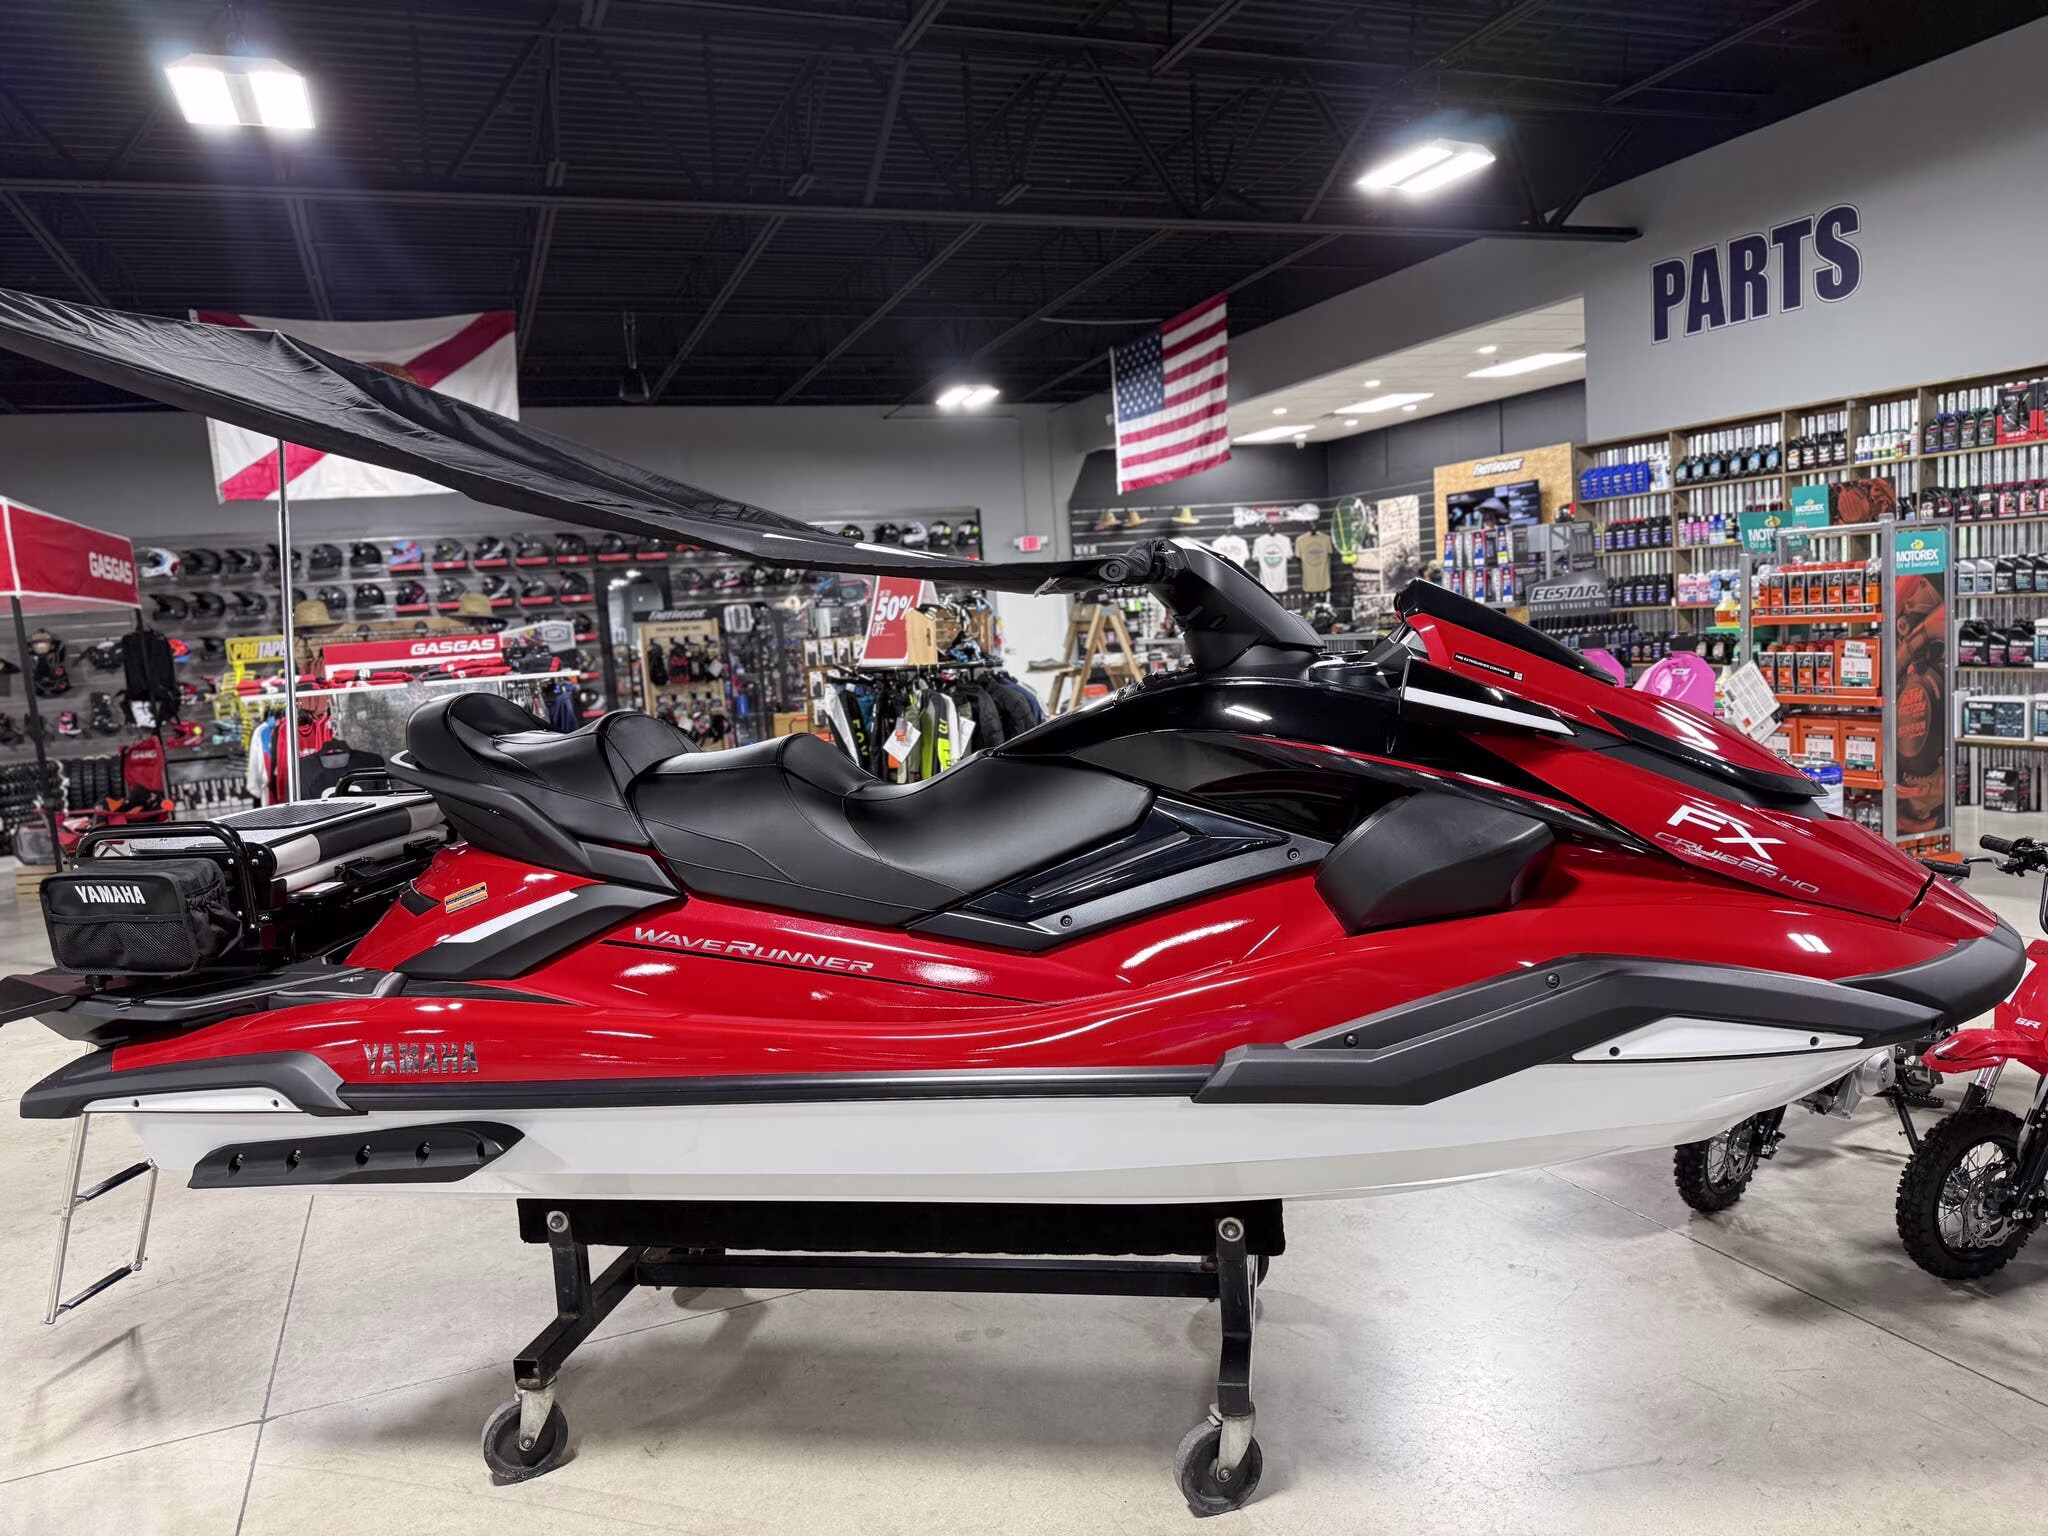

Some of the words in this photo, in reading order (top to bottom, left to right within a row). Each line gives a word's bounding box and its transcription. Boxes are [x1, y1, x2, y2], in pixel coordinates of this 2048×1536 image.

[1651, 204, 1862, 345] PARTS
[89, 551, 133, 585] GASGAS
[1896, 549, 1939, 562] MOTOREX
[1531, 583, 1601, 602] ECSTAR
[875, 595, 914, 621] 50%
[872, 621, 886, 637] OFF
[410, 638, 496, 656] GASGAS
[1667, 804, 1786, 861] FX
[1655, 832, 1778, 878] CRUISER
[1779, 875, 1820, 893] HO
[74, 885, 146, 904] YAMAHA
[362, 1041, 478, 1075] YAMAHA
